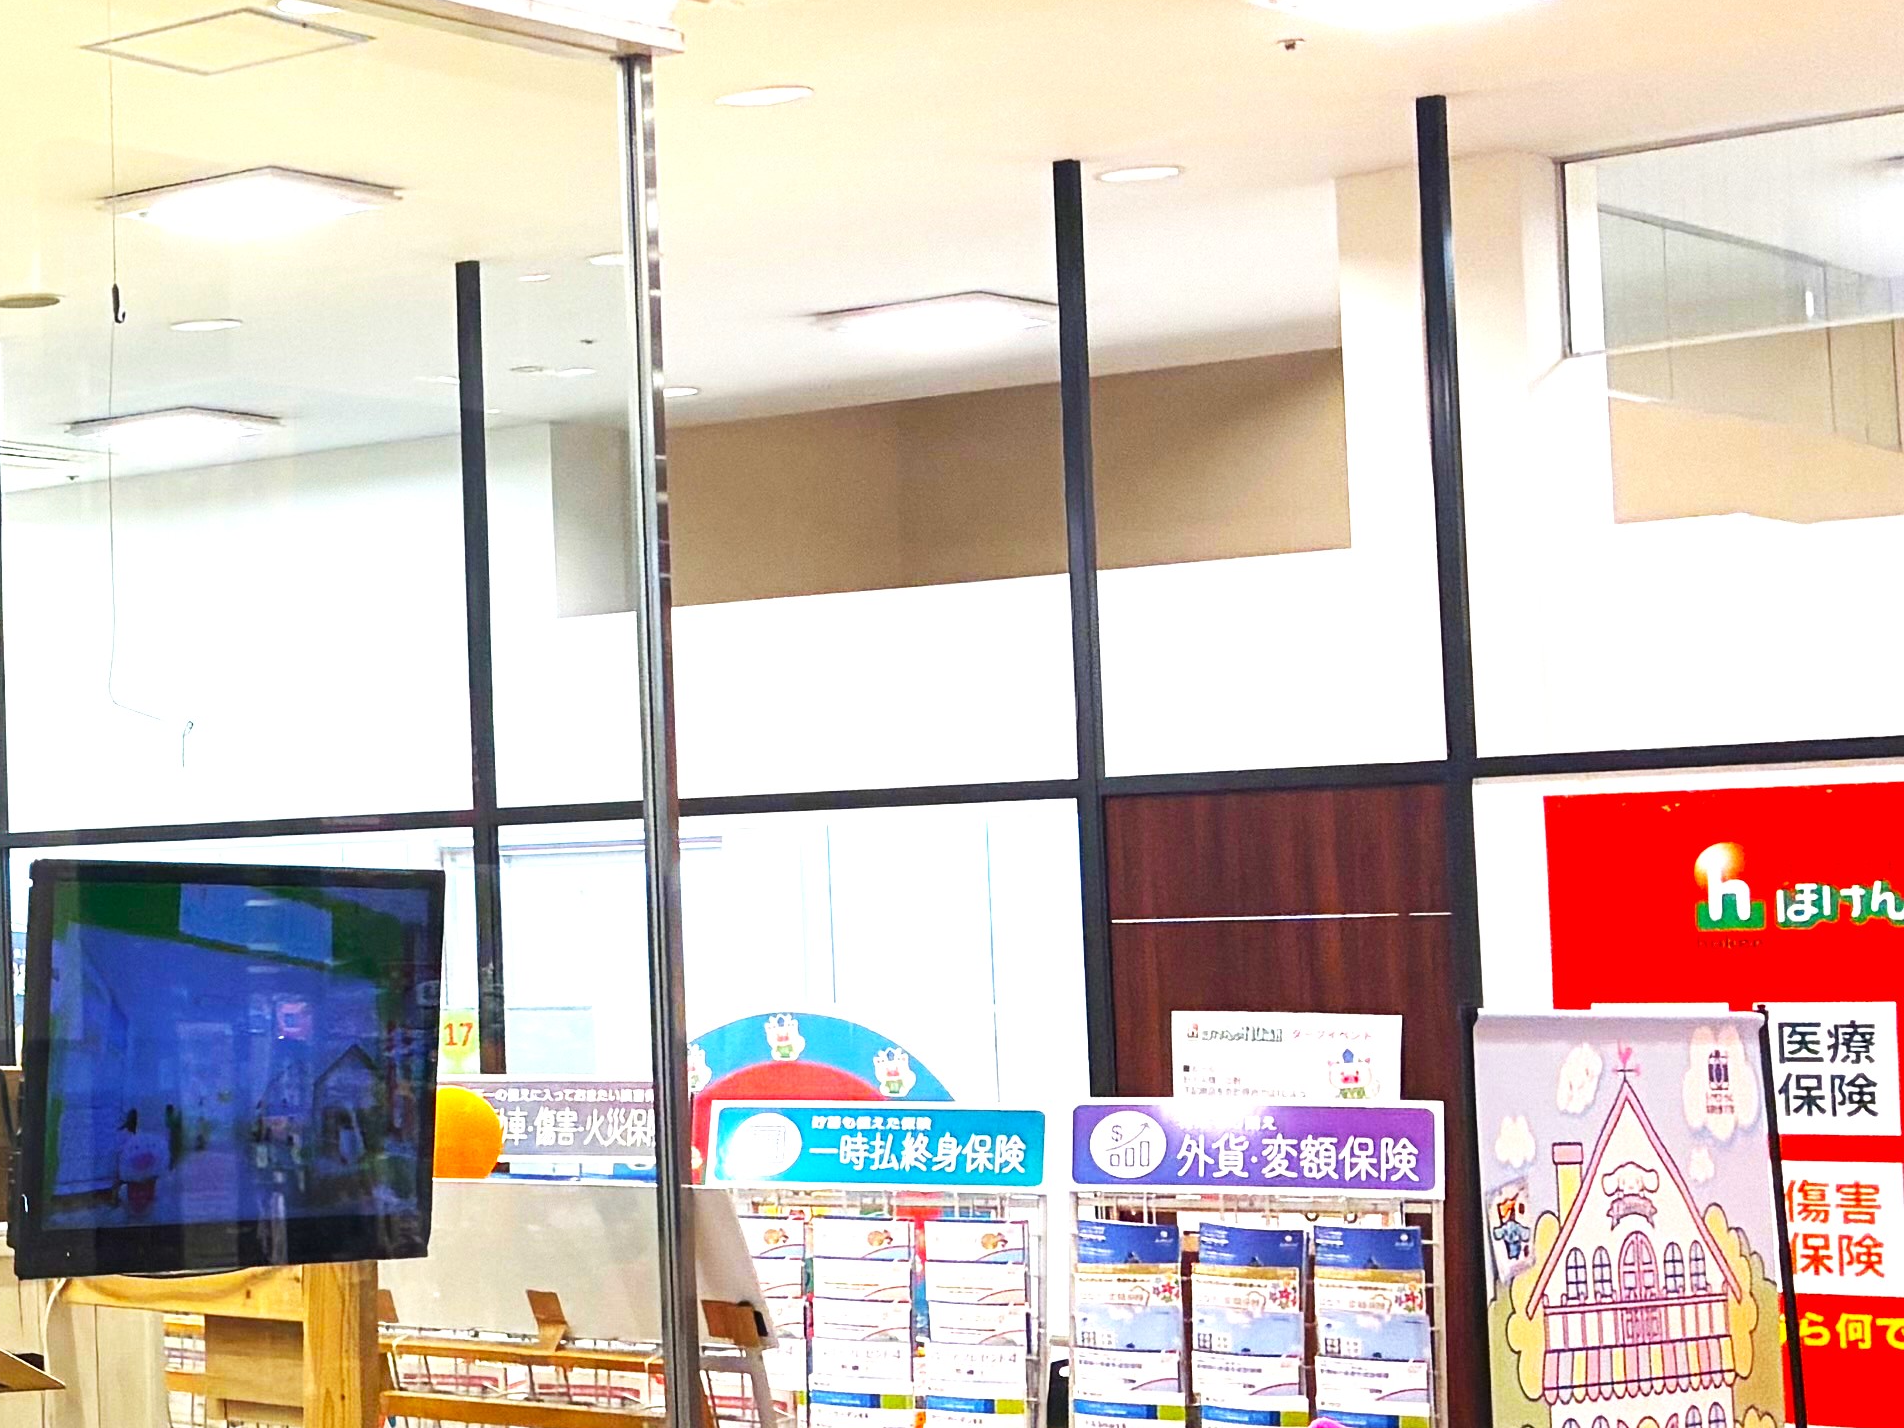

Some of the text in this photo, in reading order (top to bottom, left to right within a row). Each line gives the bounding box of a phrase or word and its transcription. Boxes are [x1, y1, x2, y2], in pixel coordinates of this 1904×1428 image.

[442, 1019, 473, 1050] 17
[1777, 1019, 1876, 1065] 医療
[1777, 1072, 1880, 1118] 保険
[808, 1132, 1027, 1174] 一時払終身保険
[1176, 1132, 1421, 1182] 外貨・変額保険
[1784, 1179, 1882, 1225] 傷害
[1790, 1231, 1885, 1278] 保険
